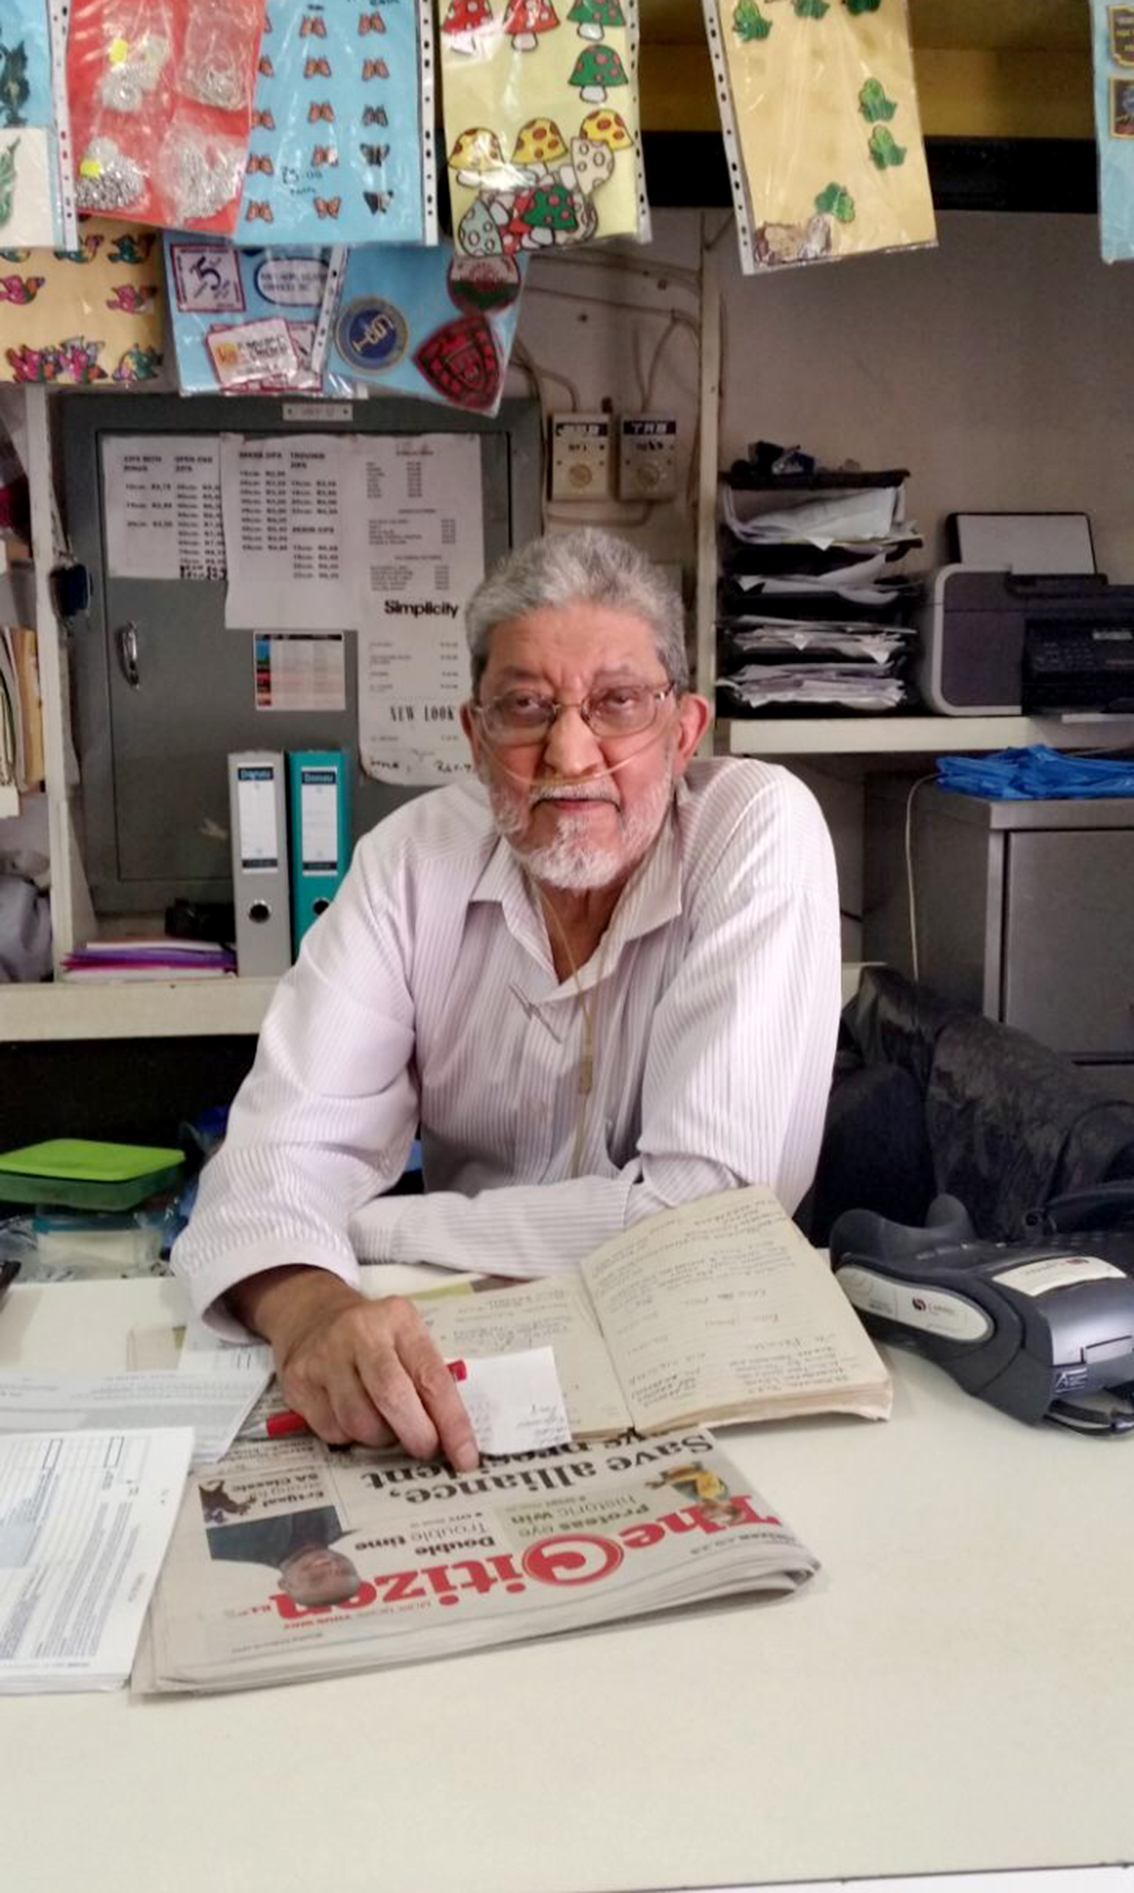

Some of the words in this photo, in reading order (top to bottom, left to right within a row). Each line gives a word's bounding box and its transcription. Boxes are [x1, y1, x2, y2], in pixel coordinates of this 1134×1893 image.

[384, 600, 459, 619] Simplicity
[389, 705, 415, 722] NEW
[424, 705, 455, 722] LOOK
[607, 1434, 714, 1471] Save
[389, 1457, 595, 1504] alliance,
[557, 1493, 637, 1518] historic
[511, 1510, 554, 1526] win
[558, 1504, 651, 1532] Proteas
[619, 1494, 781, 1548] The
[410, 1522, 487, 1542] Trouble
[518, 1522, 554, 1539] eye
[354, 1534, 406, 1551] time
[415, 1535, 496, 1556] Double
